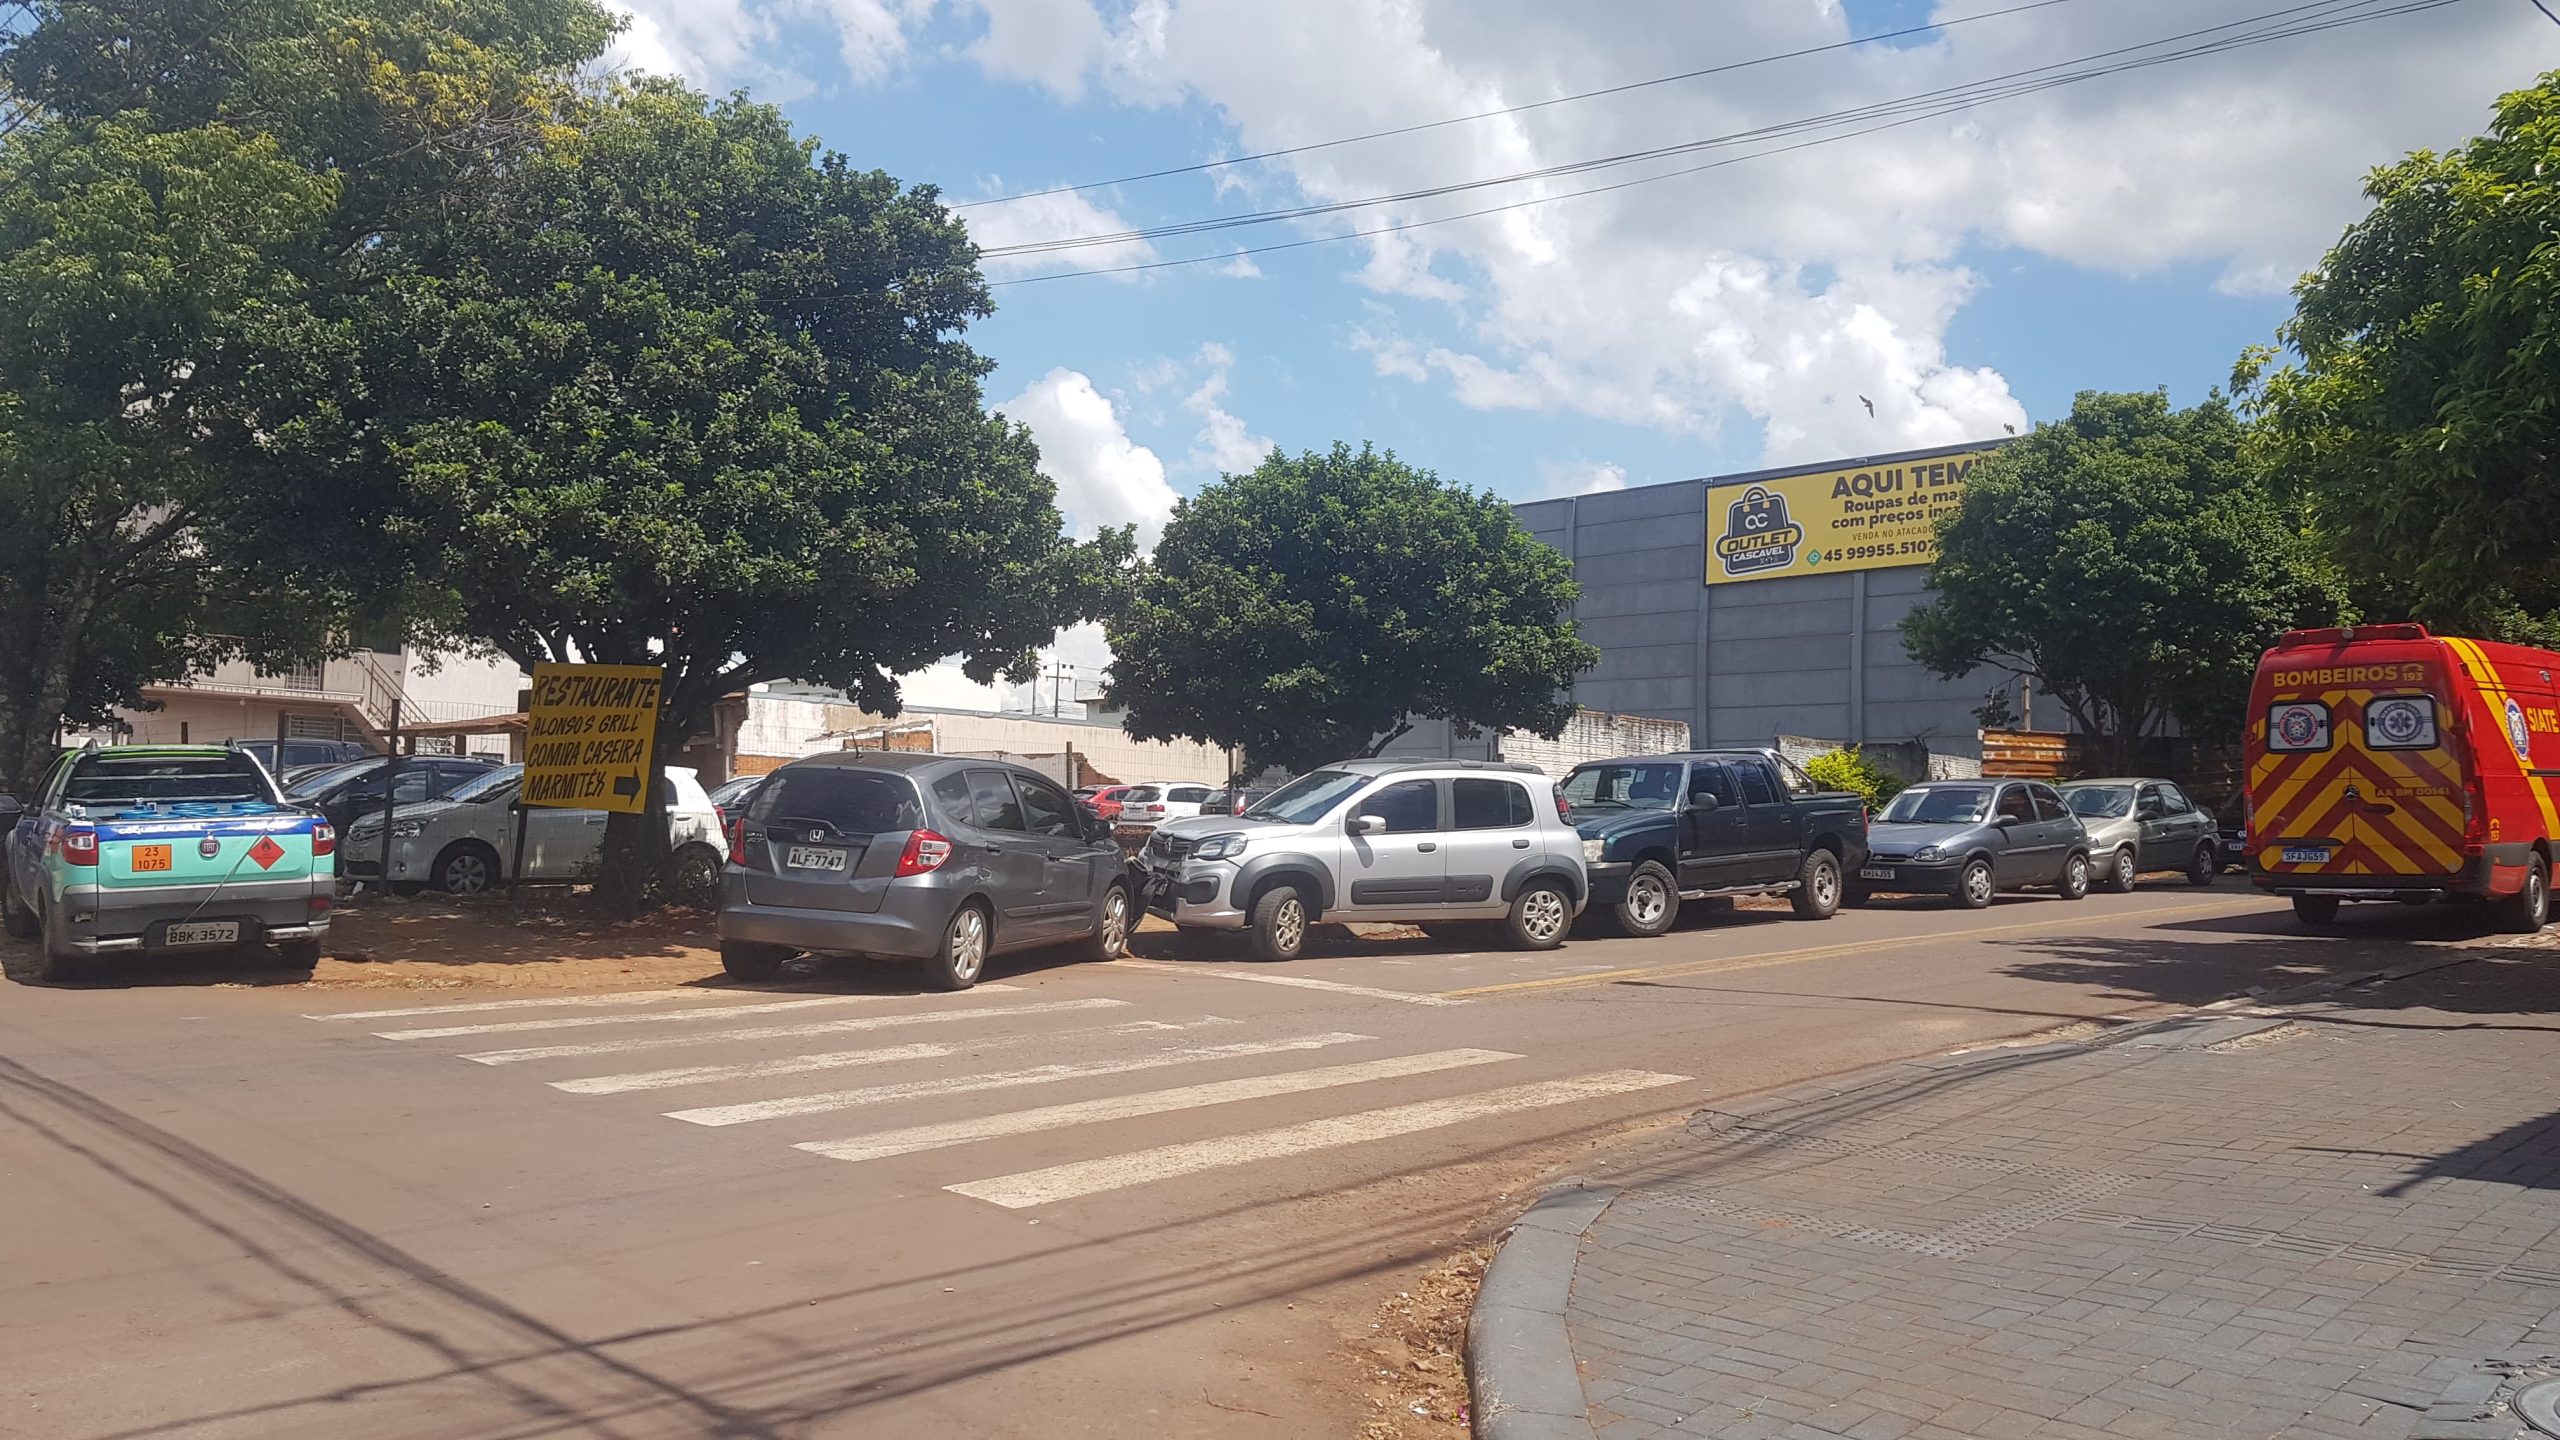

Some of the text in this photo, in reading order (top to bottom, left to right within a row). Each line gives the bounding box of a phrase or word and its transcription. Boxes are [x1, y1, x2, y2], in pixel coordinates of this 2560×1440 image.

[1831, 469, 1903, 499] AQUI
[1844, 498, 1903, 513] Roupas
[1907, 491, 1928, 505] de
[1831, 517, 1865, 529] com
[1869, 508, 1924, 528] preços
[1727, 530, 1792, 552] OUTLET
[1852, 532, 1879, 541] VENDA
[1732, 545, 1785, 562] CASCAVEL
[1823, 549, 1843, 562] 45
[2273, 665, 2398, 688] BOMBEIROS
[2403, 672, 2423, 682] 193
[532, 675, 661, 709] RESTAURANTE
[2526, 707, 2560, 734] SIATE
[528, 738, 645, 767] COMIDA CASEIRA
[2376, 788, 2396, 796] AA
[2397, 787, 2415, 796] BM
[144, 847, 159, 857] 23
[138, 859, 166, 870] 1075
[169, 929, 234, 943] BBK 3572
